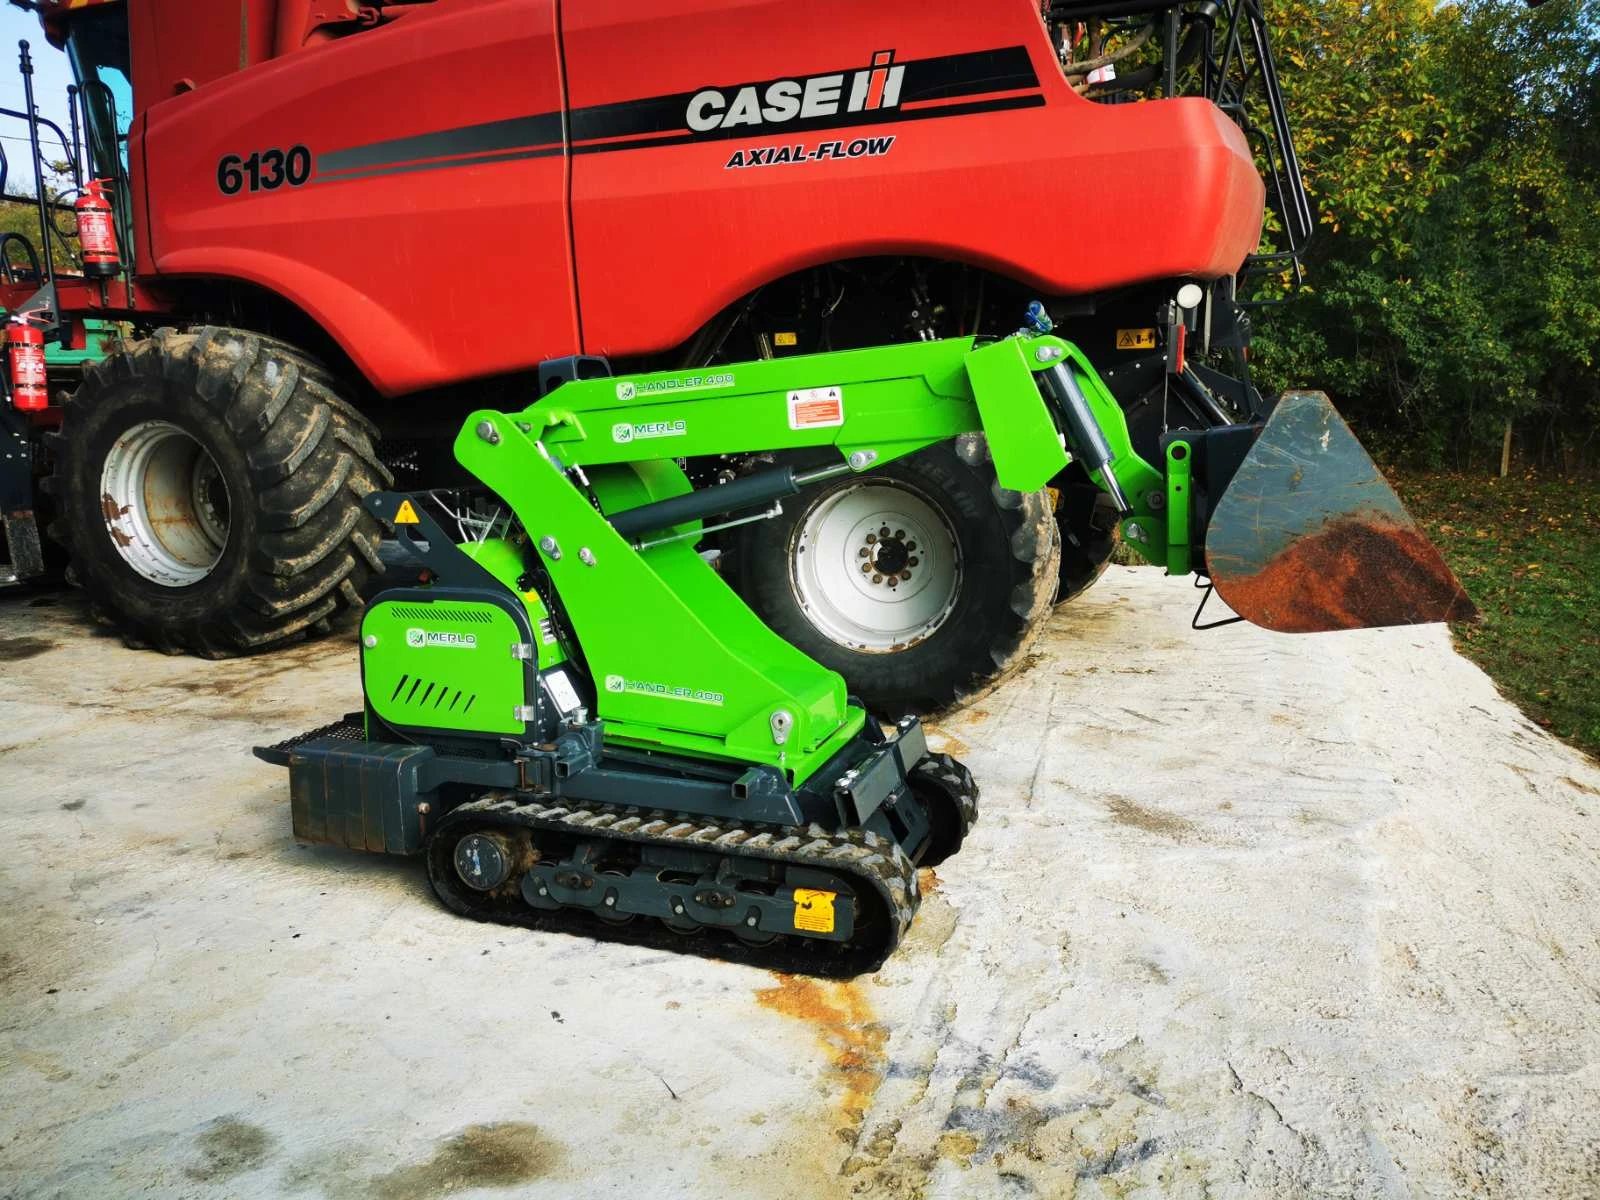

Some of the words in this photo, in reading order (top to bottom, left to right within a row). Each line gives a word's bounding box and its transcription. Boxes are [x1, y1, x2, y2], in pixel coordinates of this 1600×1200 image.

[685, 74, 844, 132] CASE
[725, 136, 896, 169] AXIAL-FLOW
[217, 144, 312, 196] 6130
[635, 376, 703, 392] HANDLER
[705, 374, 735, 385] 400
[634, 421, 686, 434] MERLO
[427, 632, 476, 644] MERLO
[624, 680, 692, 697] HANDLER
[695, 691, 724, 702] 400
